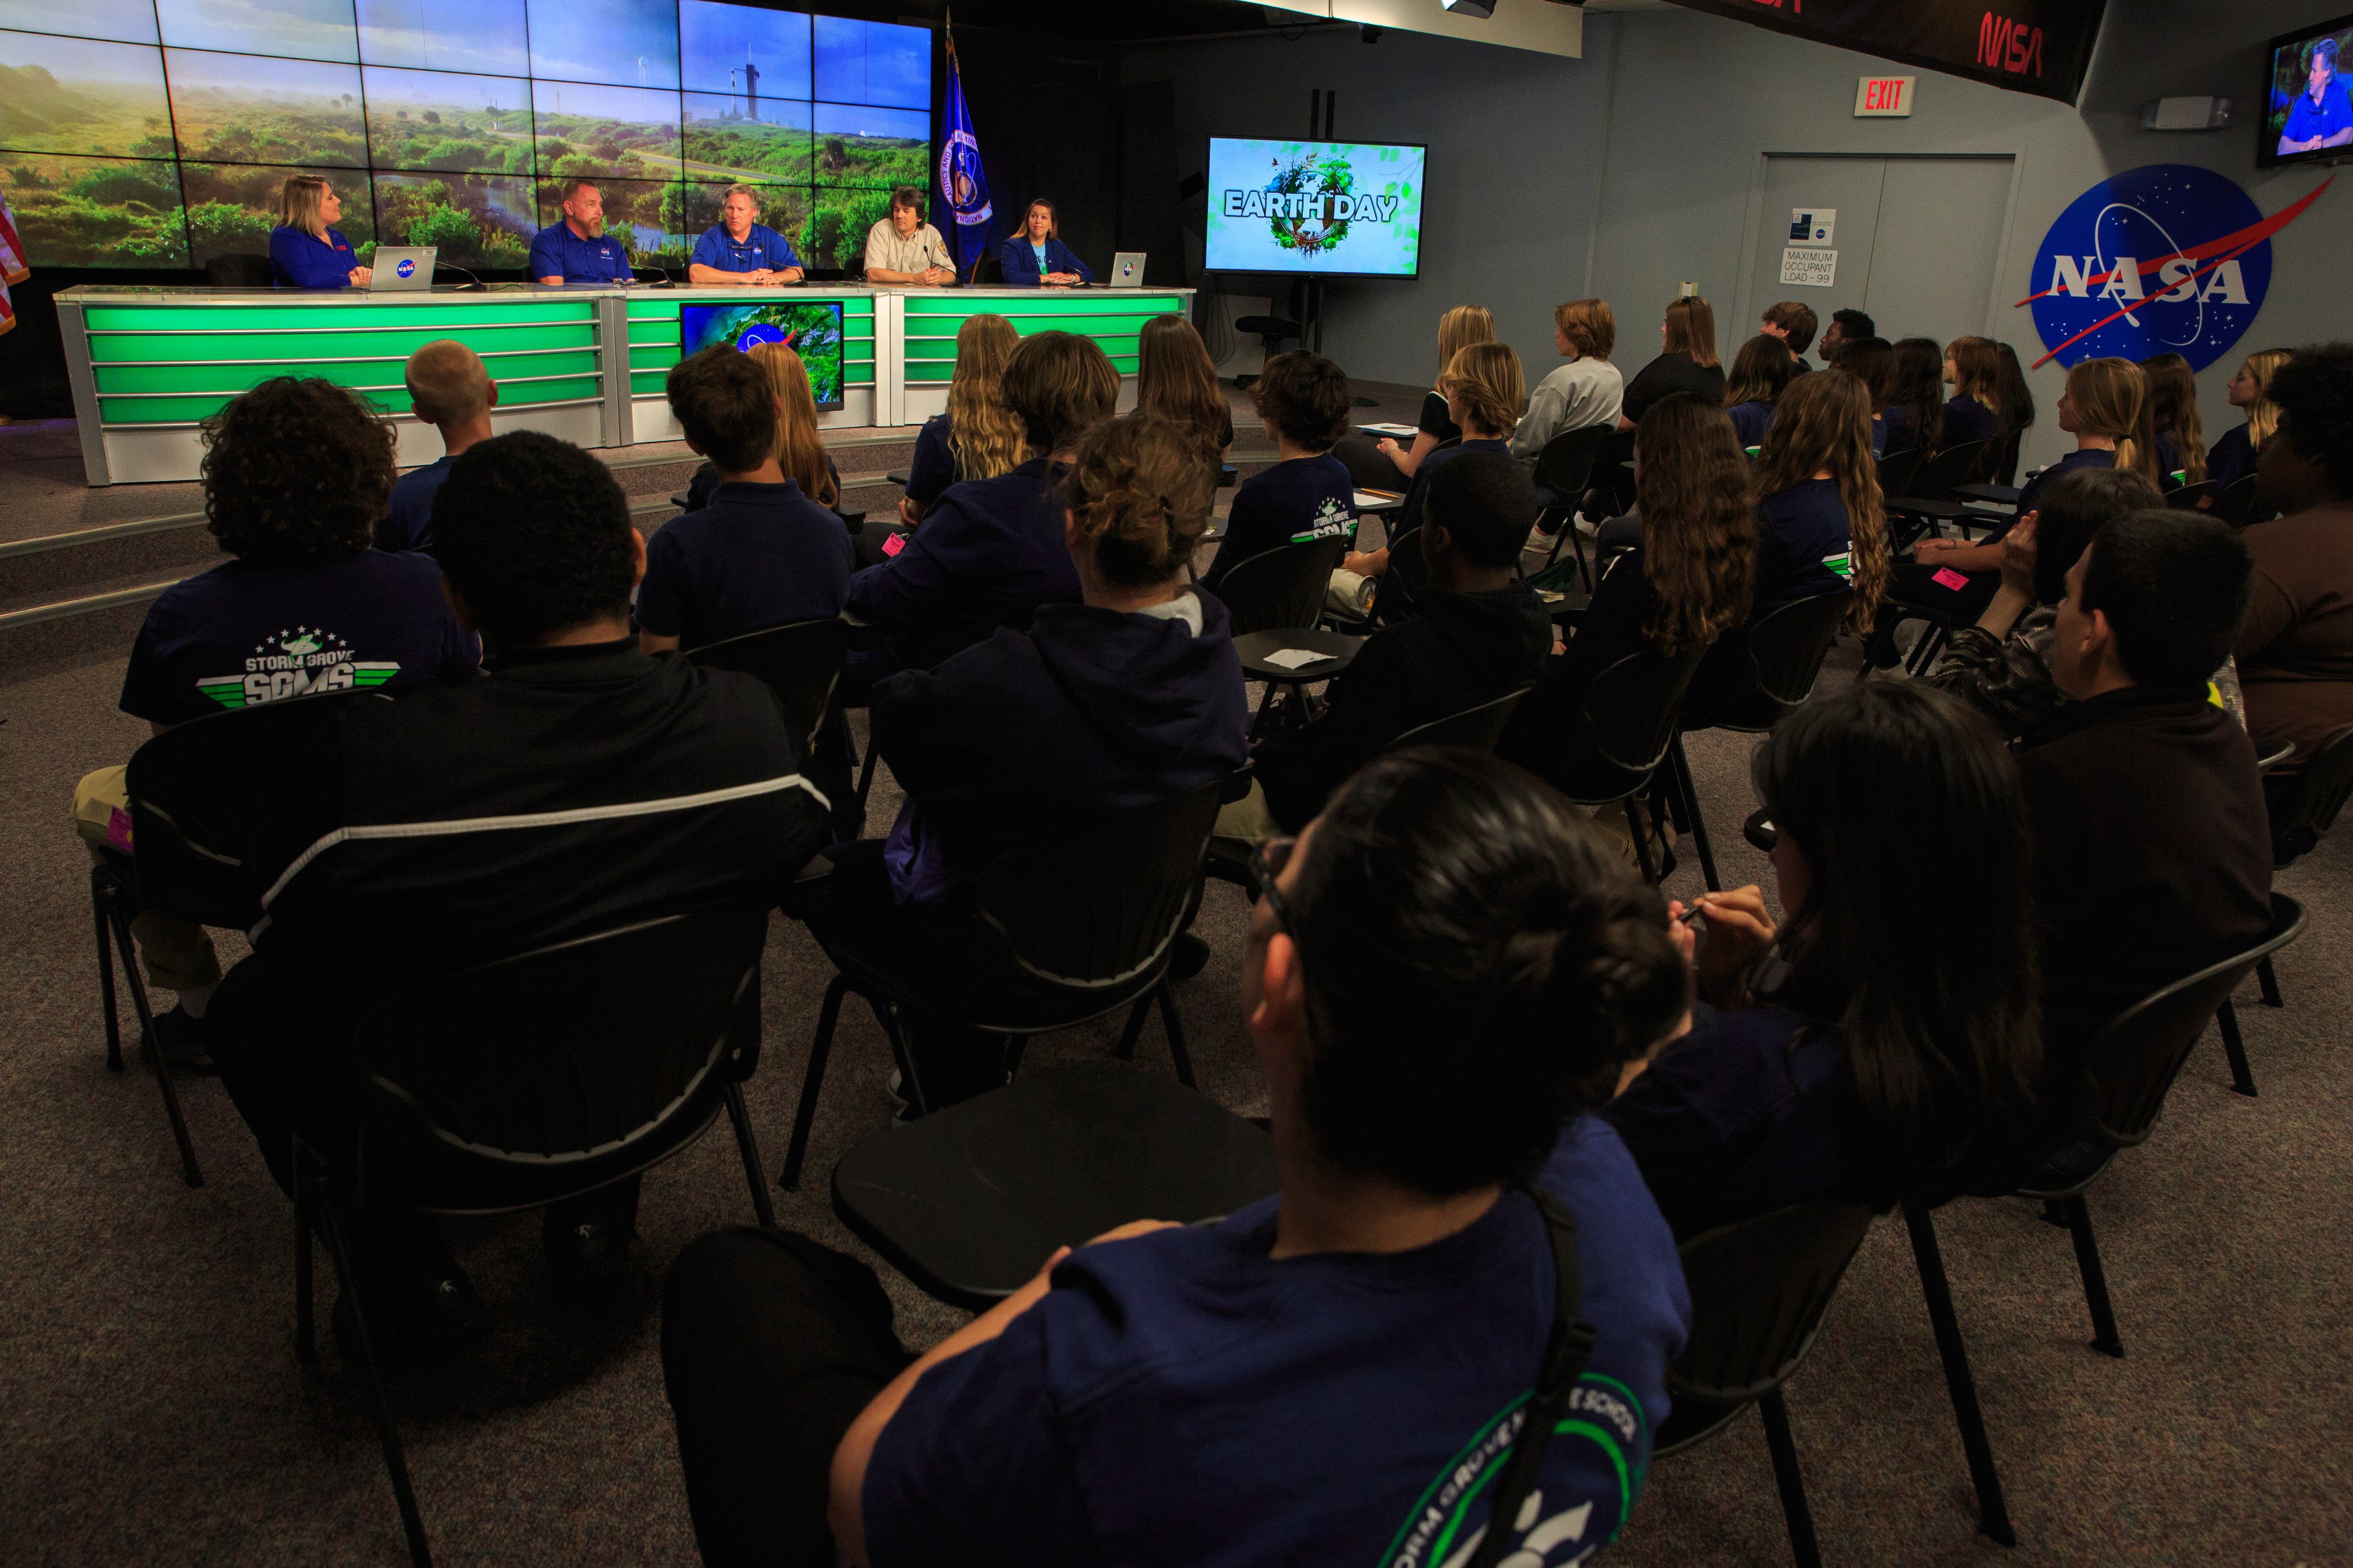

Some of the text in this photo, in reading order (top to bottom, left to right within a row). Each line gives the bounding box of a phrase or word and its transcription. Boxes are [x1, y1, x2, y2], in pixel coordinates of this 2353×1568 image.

[1977, 11, 2043, 78] NASA
[1865, 80, 1904, 110] EXIT
[943, 152, 951, 168] AND
[1224, 190, 1398, 222] EARTH DAY
[955, 213, 982, 223] NATIONA
[1788, 252, 1833, 261] MAXIMUM
[1784, 261, 1833, 272] OCCUPANT
[1784, 272, 1807, 281] LOAD
[1816, 274, 1829, 283] 99
[2046, 255, 2250, 304] NASA
[1313, 515, 1333, 528] STORM
[245, 650, 356, 672] STORM GROVE
[244, 662, 355, 705] SGMS
